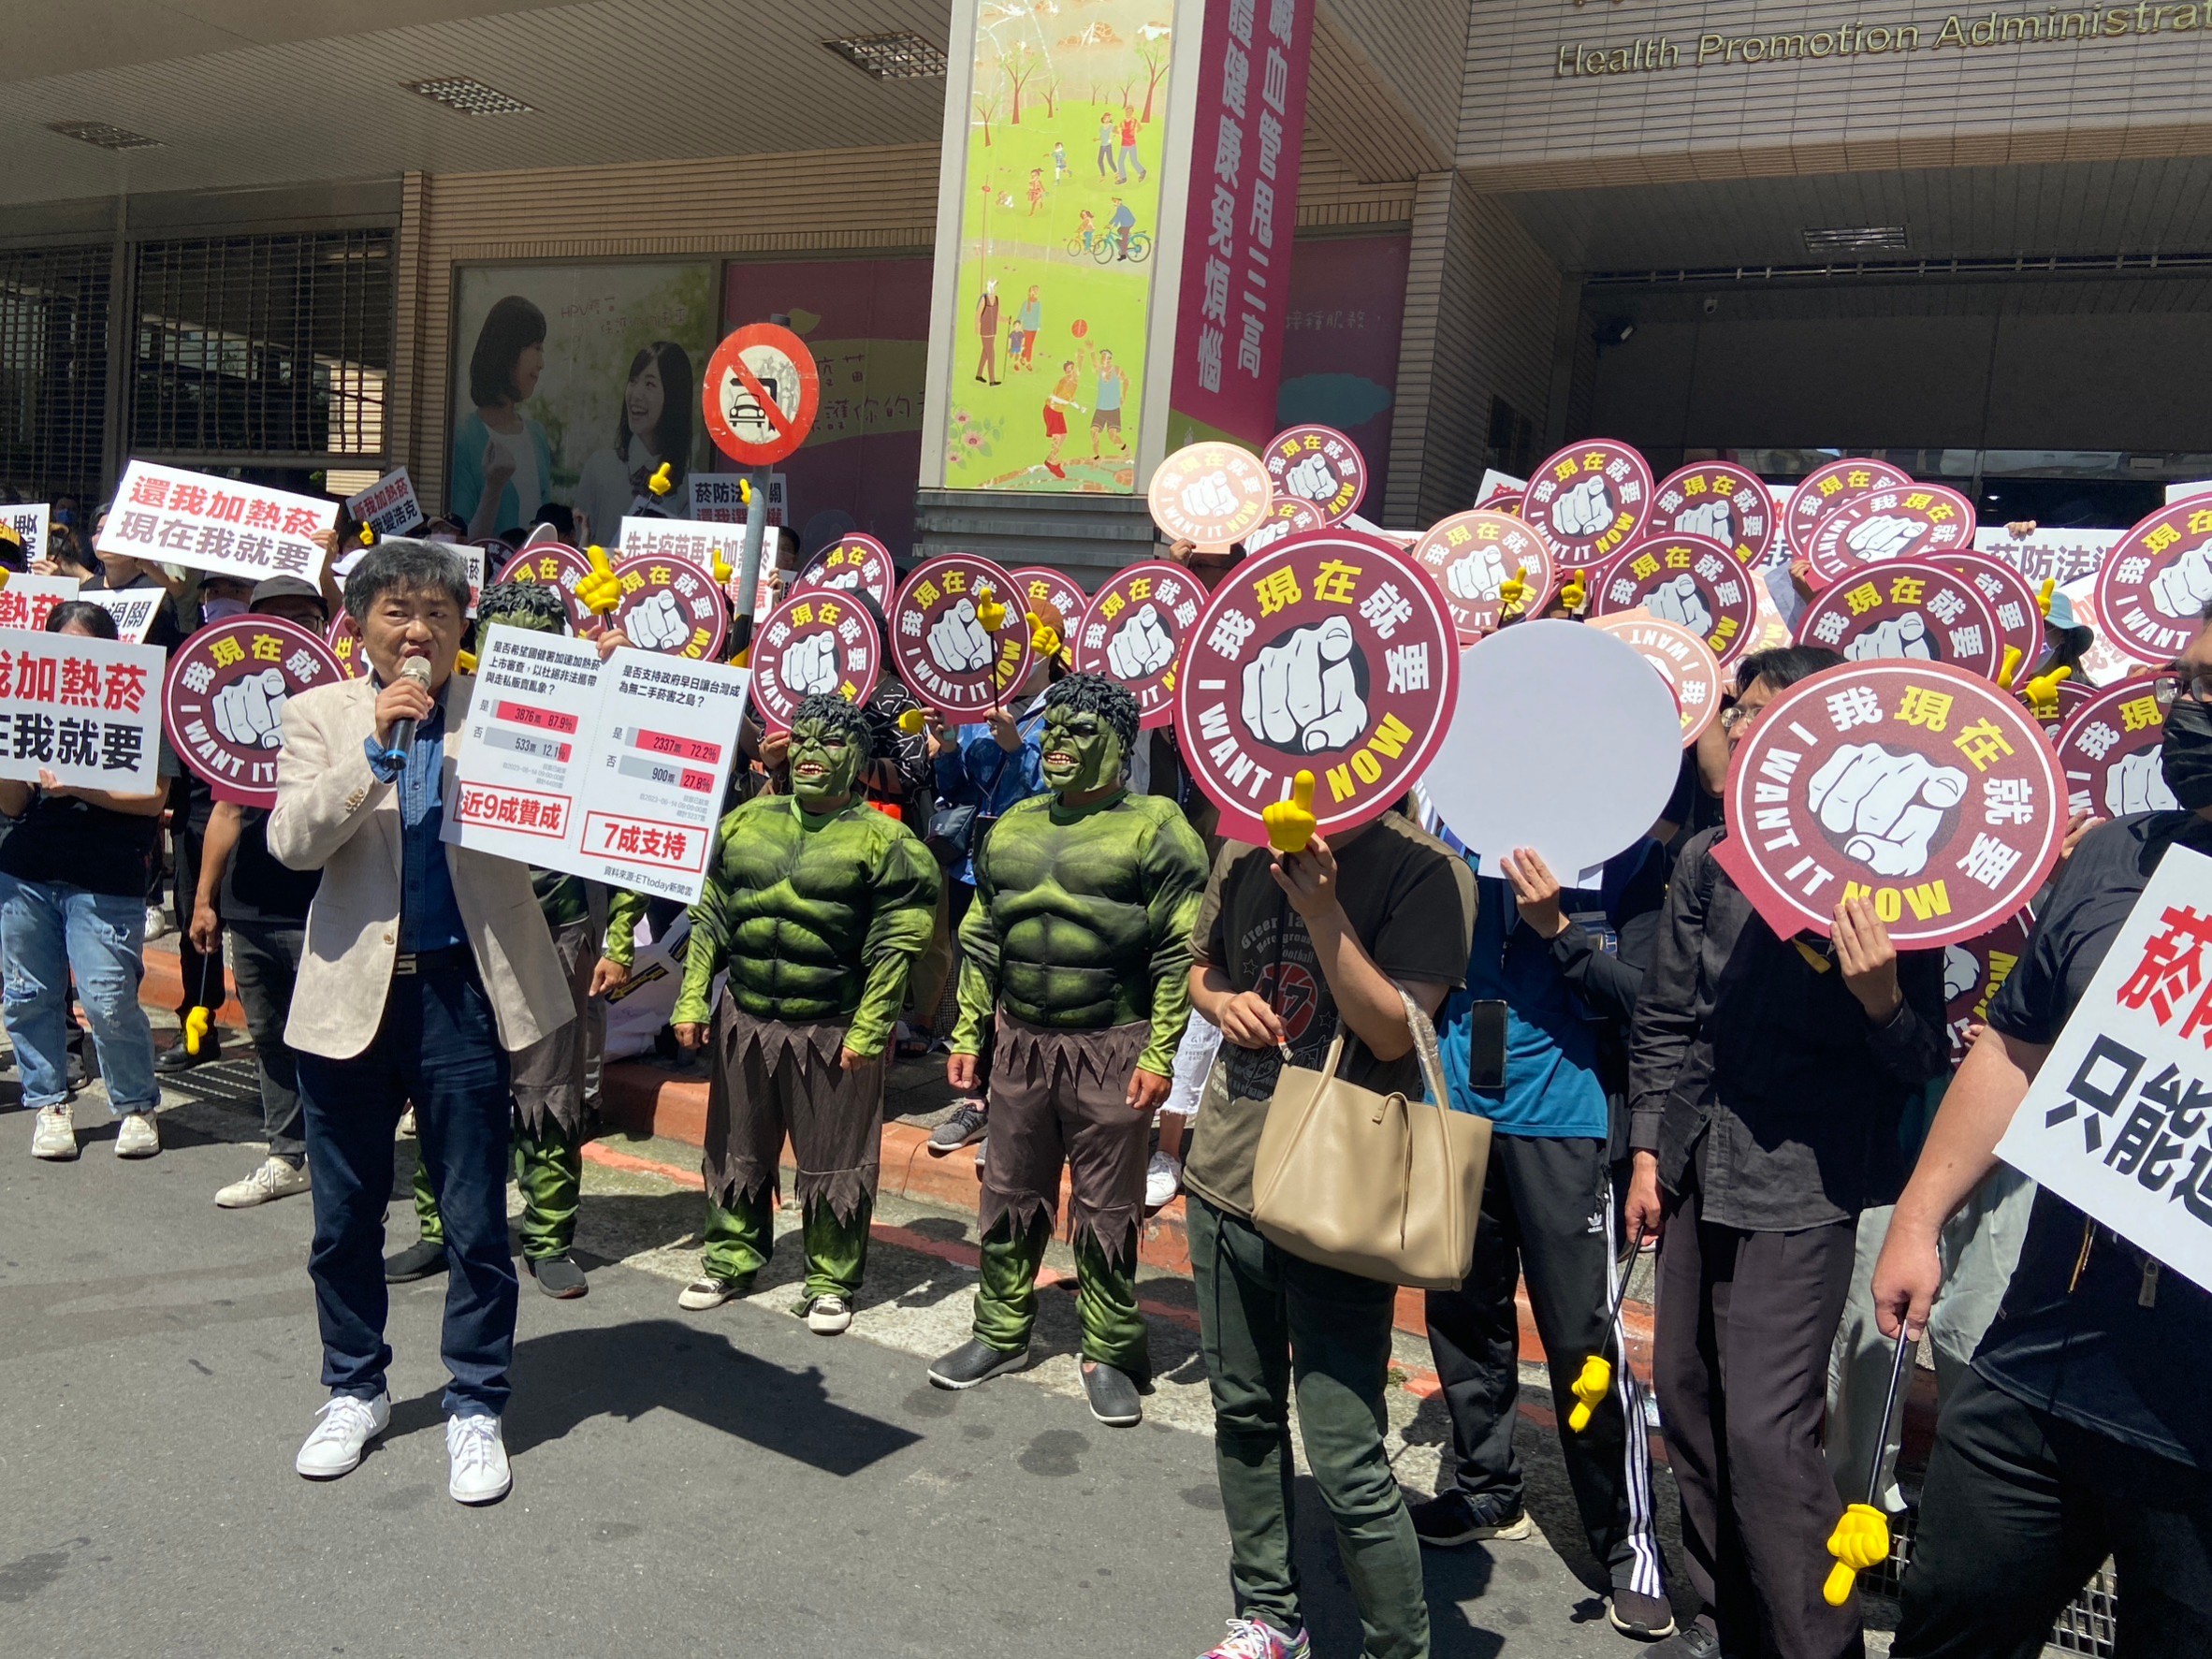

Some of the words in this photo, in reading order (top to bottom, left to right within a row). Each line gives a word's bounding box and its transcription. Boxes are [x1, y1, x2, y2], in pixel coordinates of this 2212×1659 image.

[1557, 37, 1680, 77] Health
[1695, 22, 1919, 66] Promotion
[1161, 451, 1261, 494] 我現在就要
[1268, 434, 1357, 476] 我現在就要
[695, 482, 781, 503] 菸防法關
[1328, 482, 1356, 516] NOW
[1533, 451, 1641, 504] 我現在就要
[128, 475, 322, 539] 還我加熱菸
[1165, 504, 1201, 534] WANT
[1208, 524, 1222, 538] IT
[1227, 500, 1259, 532] NOW
[1657, 474, 1763, 537] 我現在就要
[116, 510, 313, 575] 現在我就要
[1424, 521, 1542, 575] 我現在就要
[1574, 545, 1591, 561] IT
[1595, 512, 1635, 555] NOW
[1818, 519, 1851, 559] WANT
[2115, 508, 2212, 585] 我現在
[1609, 546, 1742, 606] 我現在就要
[1824, 559, 1848, 574] IT
[1084, 577, 1198, 648] 我現在就要
[1207, 559, 1430, 693] 我現在就要
[1475, 612, 1492, 626] IT
[1708, 615, 1739, 652] OW
[1812, 575, 1984, 659] 我現在就要
[2121, 606, 2191, 650] WANT
[766, 602, 866, 672] 我現在就要
[182, 633, 322, 695] 我現在就
[622, 664, 741, 697] 是否支持政府早日讓台灣成
[913, 659, 963, 702] WANT
[969, 681, 987, 702] IT
[1199, 679, 1226, 691] I
[619, 681, 705, 707] 為無二手菸害之島？
[760, 667, 793, 718] WANT
[480, 700, 488, 711] 是
[547, 715, 572, 731] 87.9%
[1788, 720, 1818, 747] I
[184, 719, 244, 778] WANT
[253, 763, 275, 783] IT
[473, 726, 483, 738] 否
[543, 744, 566, 760] 12.1%
[612, 727, 622, 739] 是
[691, 744, 717, 761] 72.2%
[1199, 702, 1273, 799] WANT
[1325, 711, 1414, 804] NOW
[606, 755, 617, 767] 否
[683, 775, 710, 792] 27.8%
[1825, 684, 2034, 891] 我現在就要
[461, 790, 562, 831] 近9成贊成
[1754, 747, 1802, 852] WANT
[604, 822, 687, 861] 7成支持
[1783, 854, 1834, 896] IT
[1841, 879, 1952, 923] NOW
